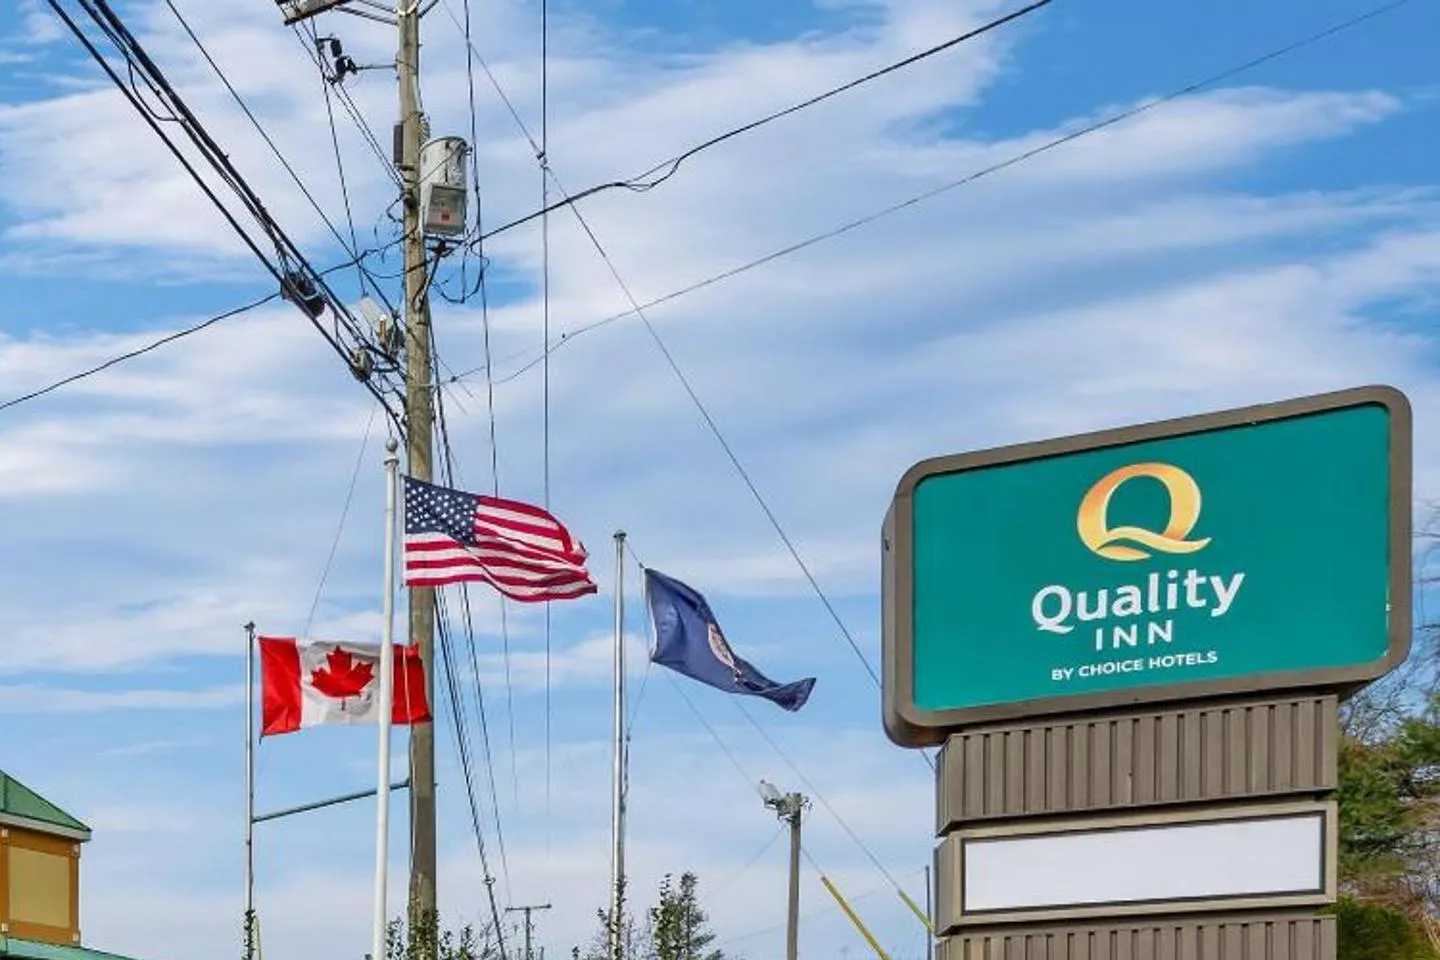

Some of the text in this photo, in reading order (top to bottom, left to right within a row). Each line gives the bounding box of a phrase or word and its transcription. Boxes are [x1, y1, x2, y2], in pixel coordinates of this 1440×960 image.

[1031, 569, 1245, 634] Quality
[1095, 619, 1173, 651] INN
[1051, 650, 1218, 681] BY CHOICE HOTELS
